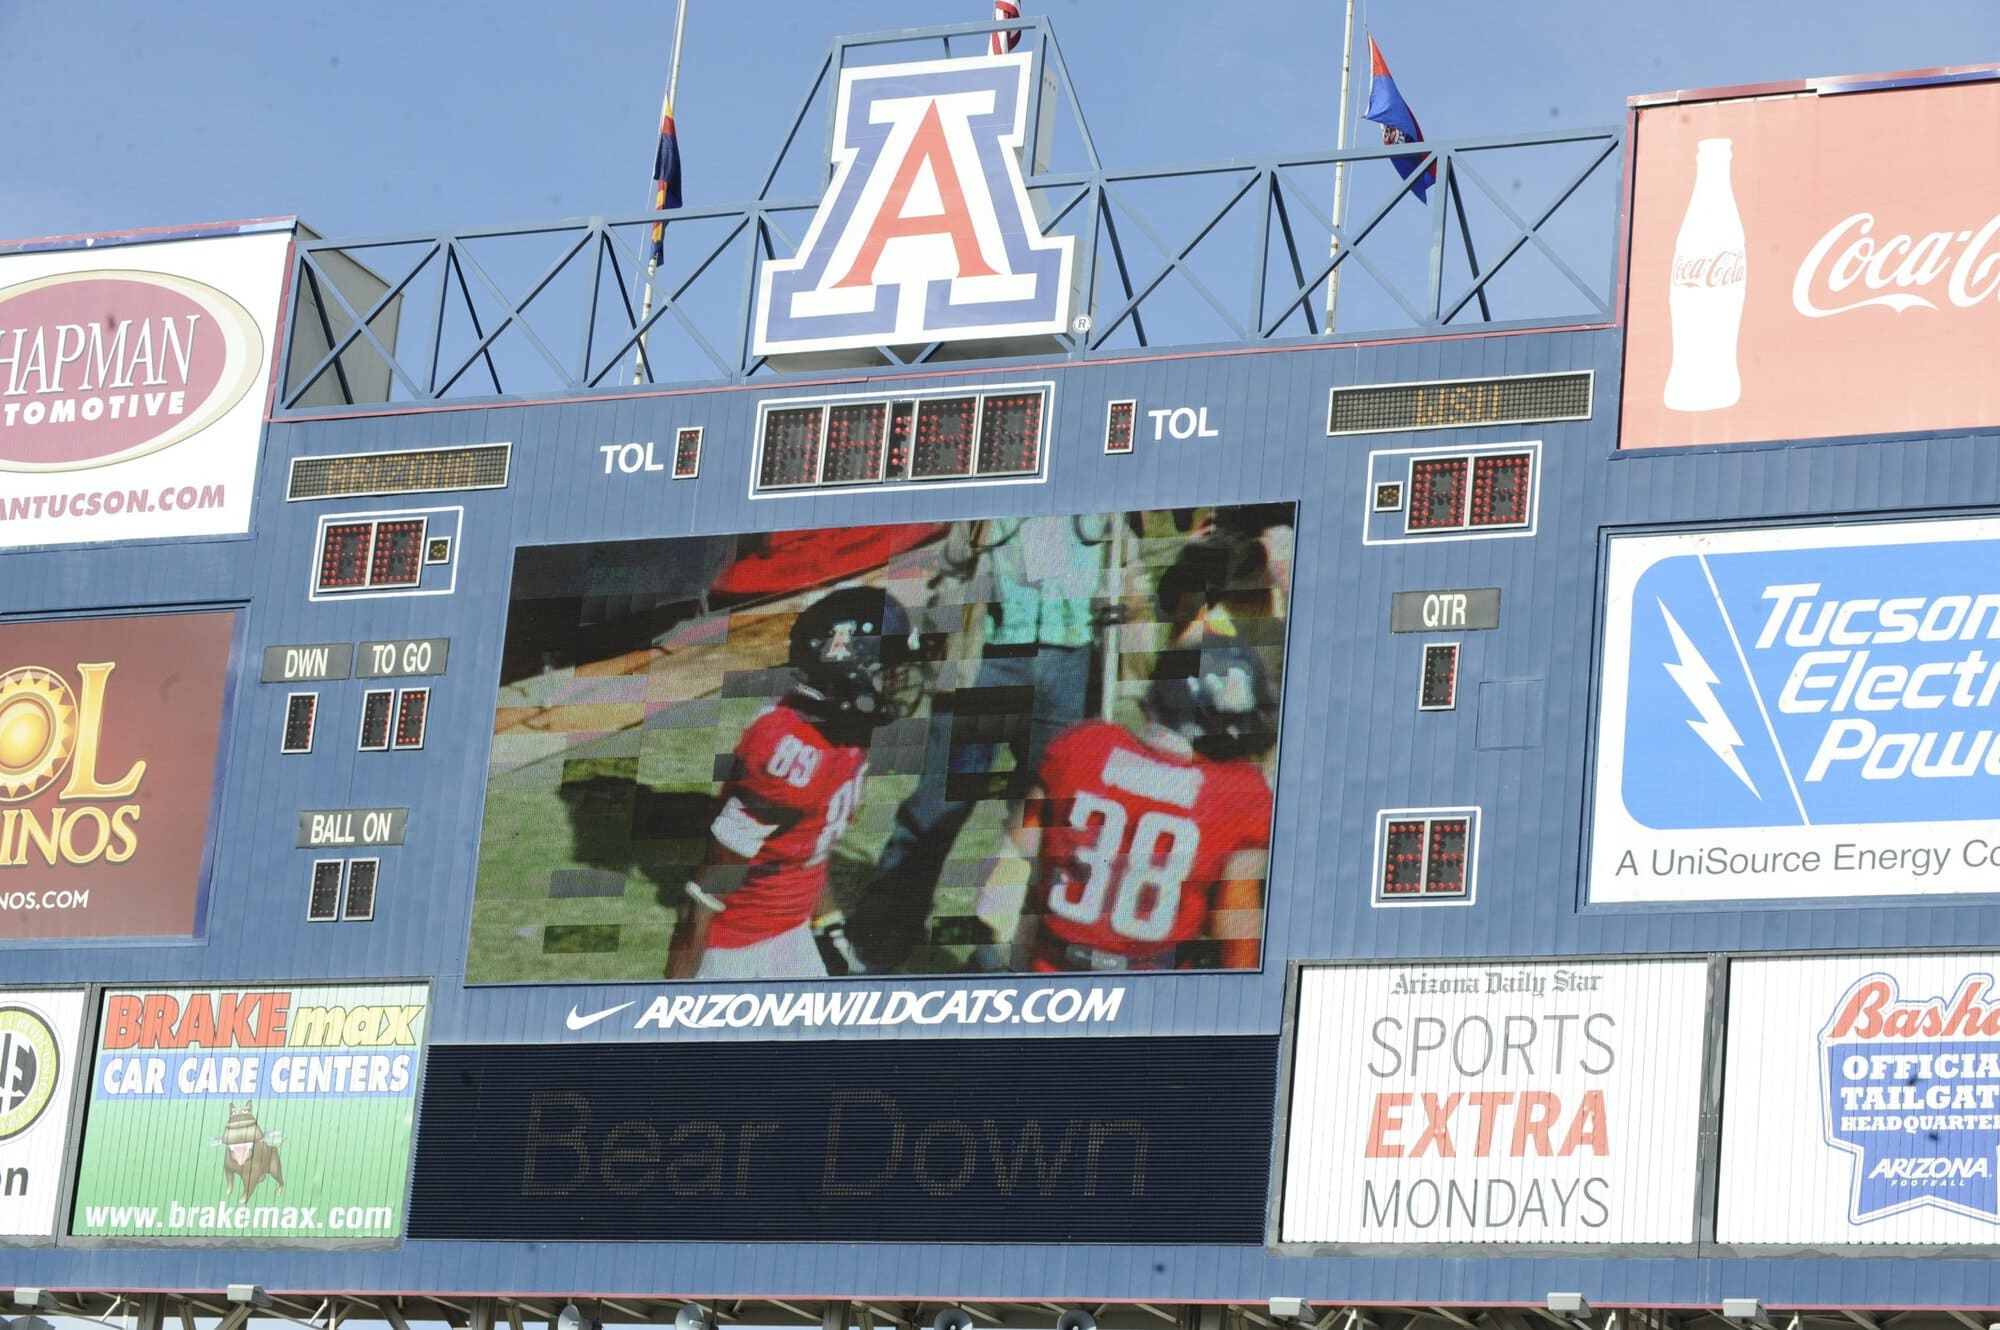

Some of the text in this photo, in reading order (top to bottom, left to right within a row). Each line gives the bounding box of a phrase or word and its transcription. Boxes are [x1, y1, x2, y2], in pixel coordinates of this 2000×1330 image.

[1417, 384, 1500, 426] WSU
[1148, 408, 1219, 441] TOL
[326, 451, 475, 495] ARIZONA
[600, 444, 664, 474] TOL
[1423, 593, 1468, 627] QTR
[285, 648, 328, 679] DWN
[373, 641, 432, 674] TO GO
[310, 812, 391, 844] BALL ON
[1049, 790, 1201, 941] 38
[1616, 850, 1639, 876] A
[1652, 846, 1821, 876] UniSource
[1833, 843, 1951, 877] Energy
[1391, 969, 1604, 999] Arizona Daily Star
[635, 988, 1125, 1029] ARIZONAWILDCATS.COM
[1368, 1012, 1616, 1078] SPORTS
[103, 1053, 411, 1096] CAR CARE CENTERS
[1840, 1085, 2000, 1111] TAILGAT
[1365, 1089, 1610, 1158] EXTRA
[522, 1088, 1148, 1197] Bear Down
[1868, 1157, 1988, 1179] ARIZONA
[1891, 1179, 1966, 1187] FOOTBALL
[1362, 1177, 1610, 1229] MONDAYS
